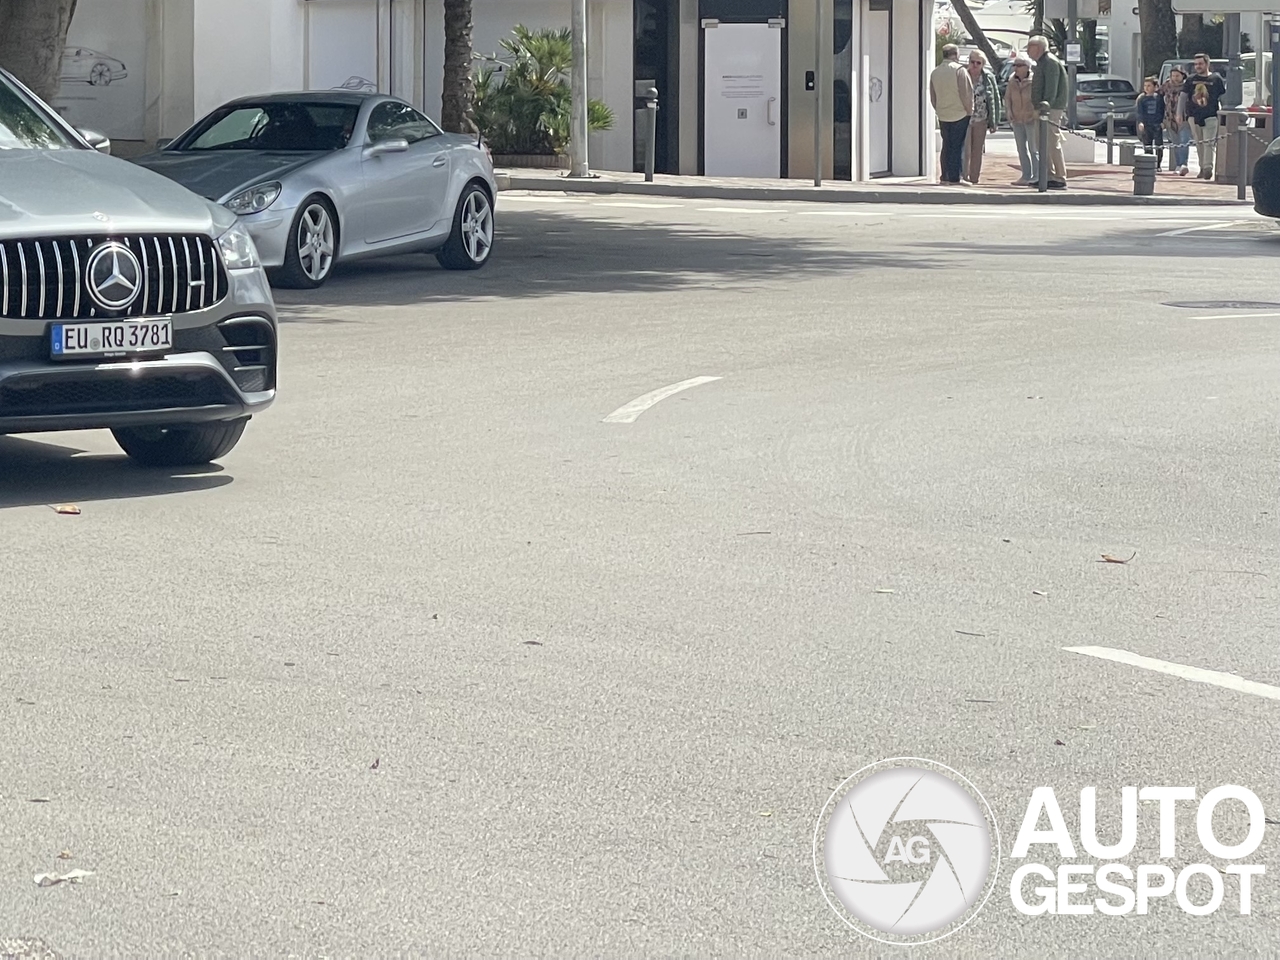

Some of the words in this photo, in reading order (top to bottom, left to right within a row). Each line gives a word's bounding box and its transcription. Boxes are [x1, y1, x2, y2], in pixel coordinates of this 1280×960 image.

[65, 330, 88, 350] EU
[102, 326, 125, 348] RQ
[129, 323, 170, 346] 3781
